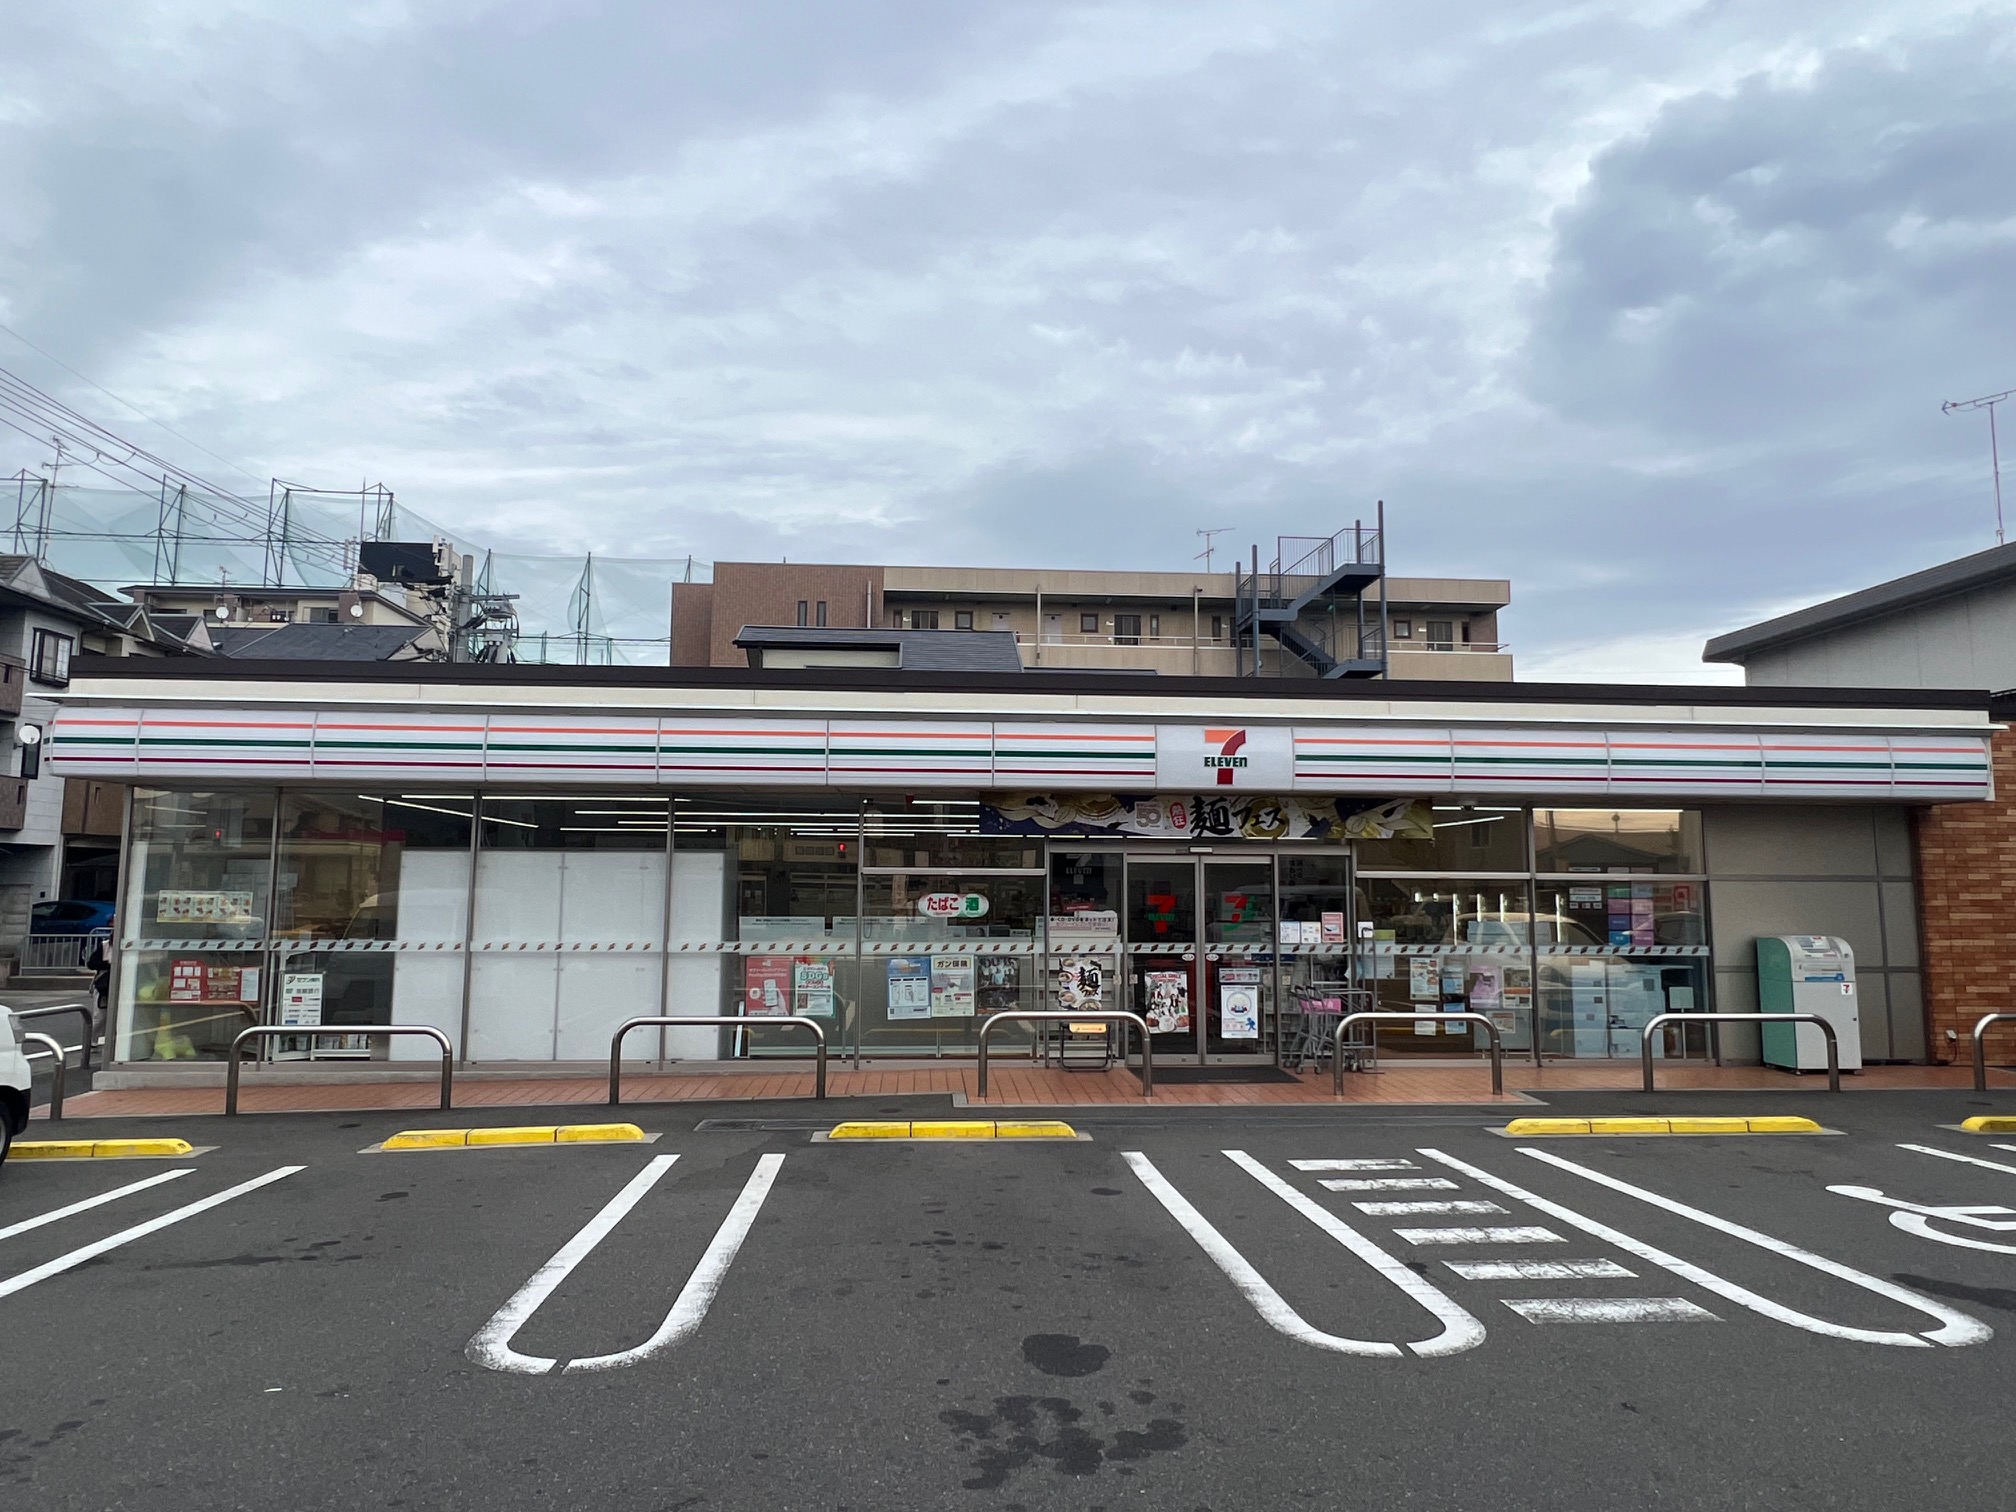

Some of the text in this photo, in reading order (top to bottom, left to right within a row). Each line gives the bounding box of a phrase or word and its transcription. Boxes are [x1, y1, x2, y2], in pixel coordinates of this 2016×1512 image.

[1204, 729, 1247, 785] 7
[927, 897, 979, 910] たばこ 酒
